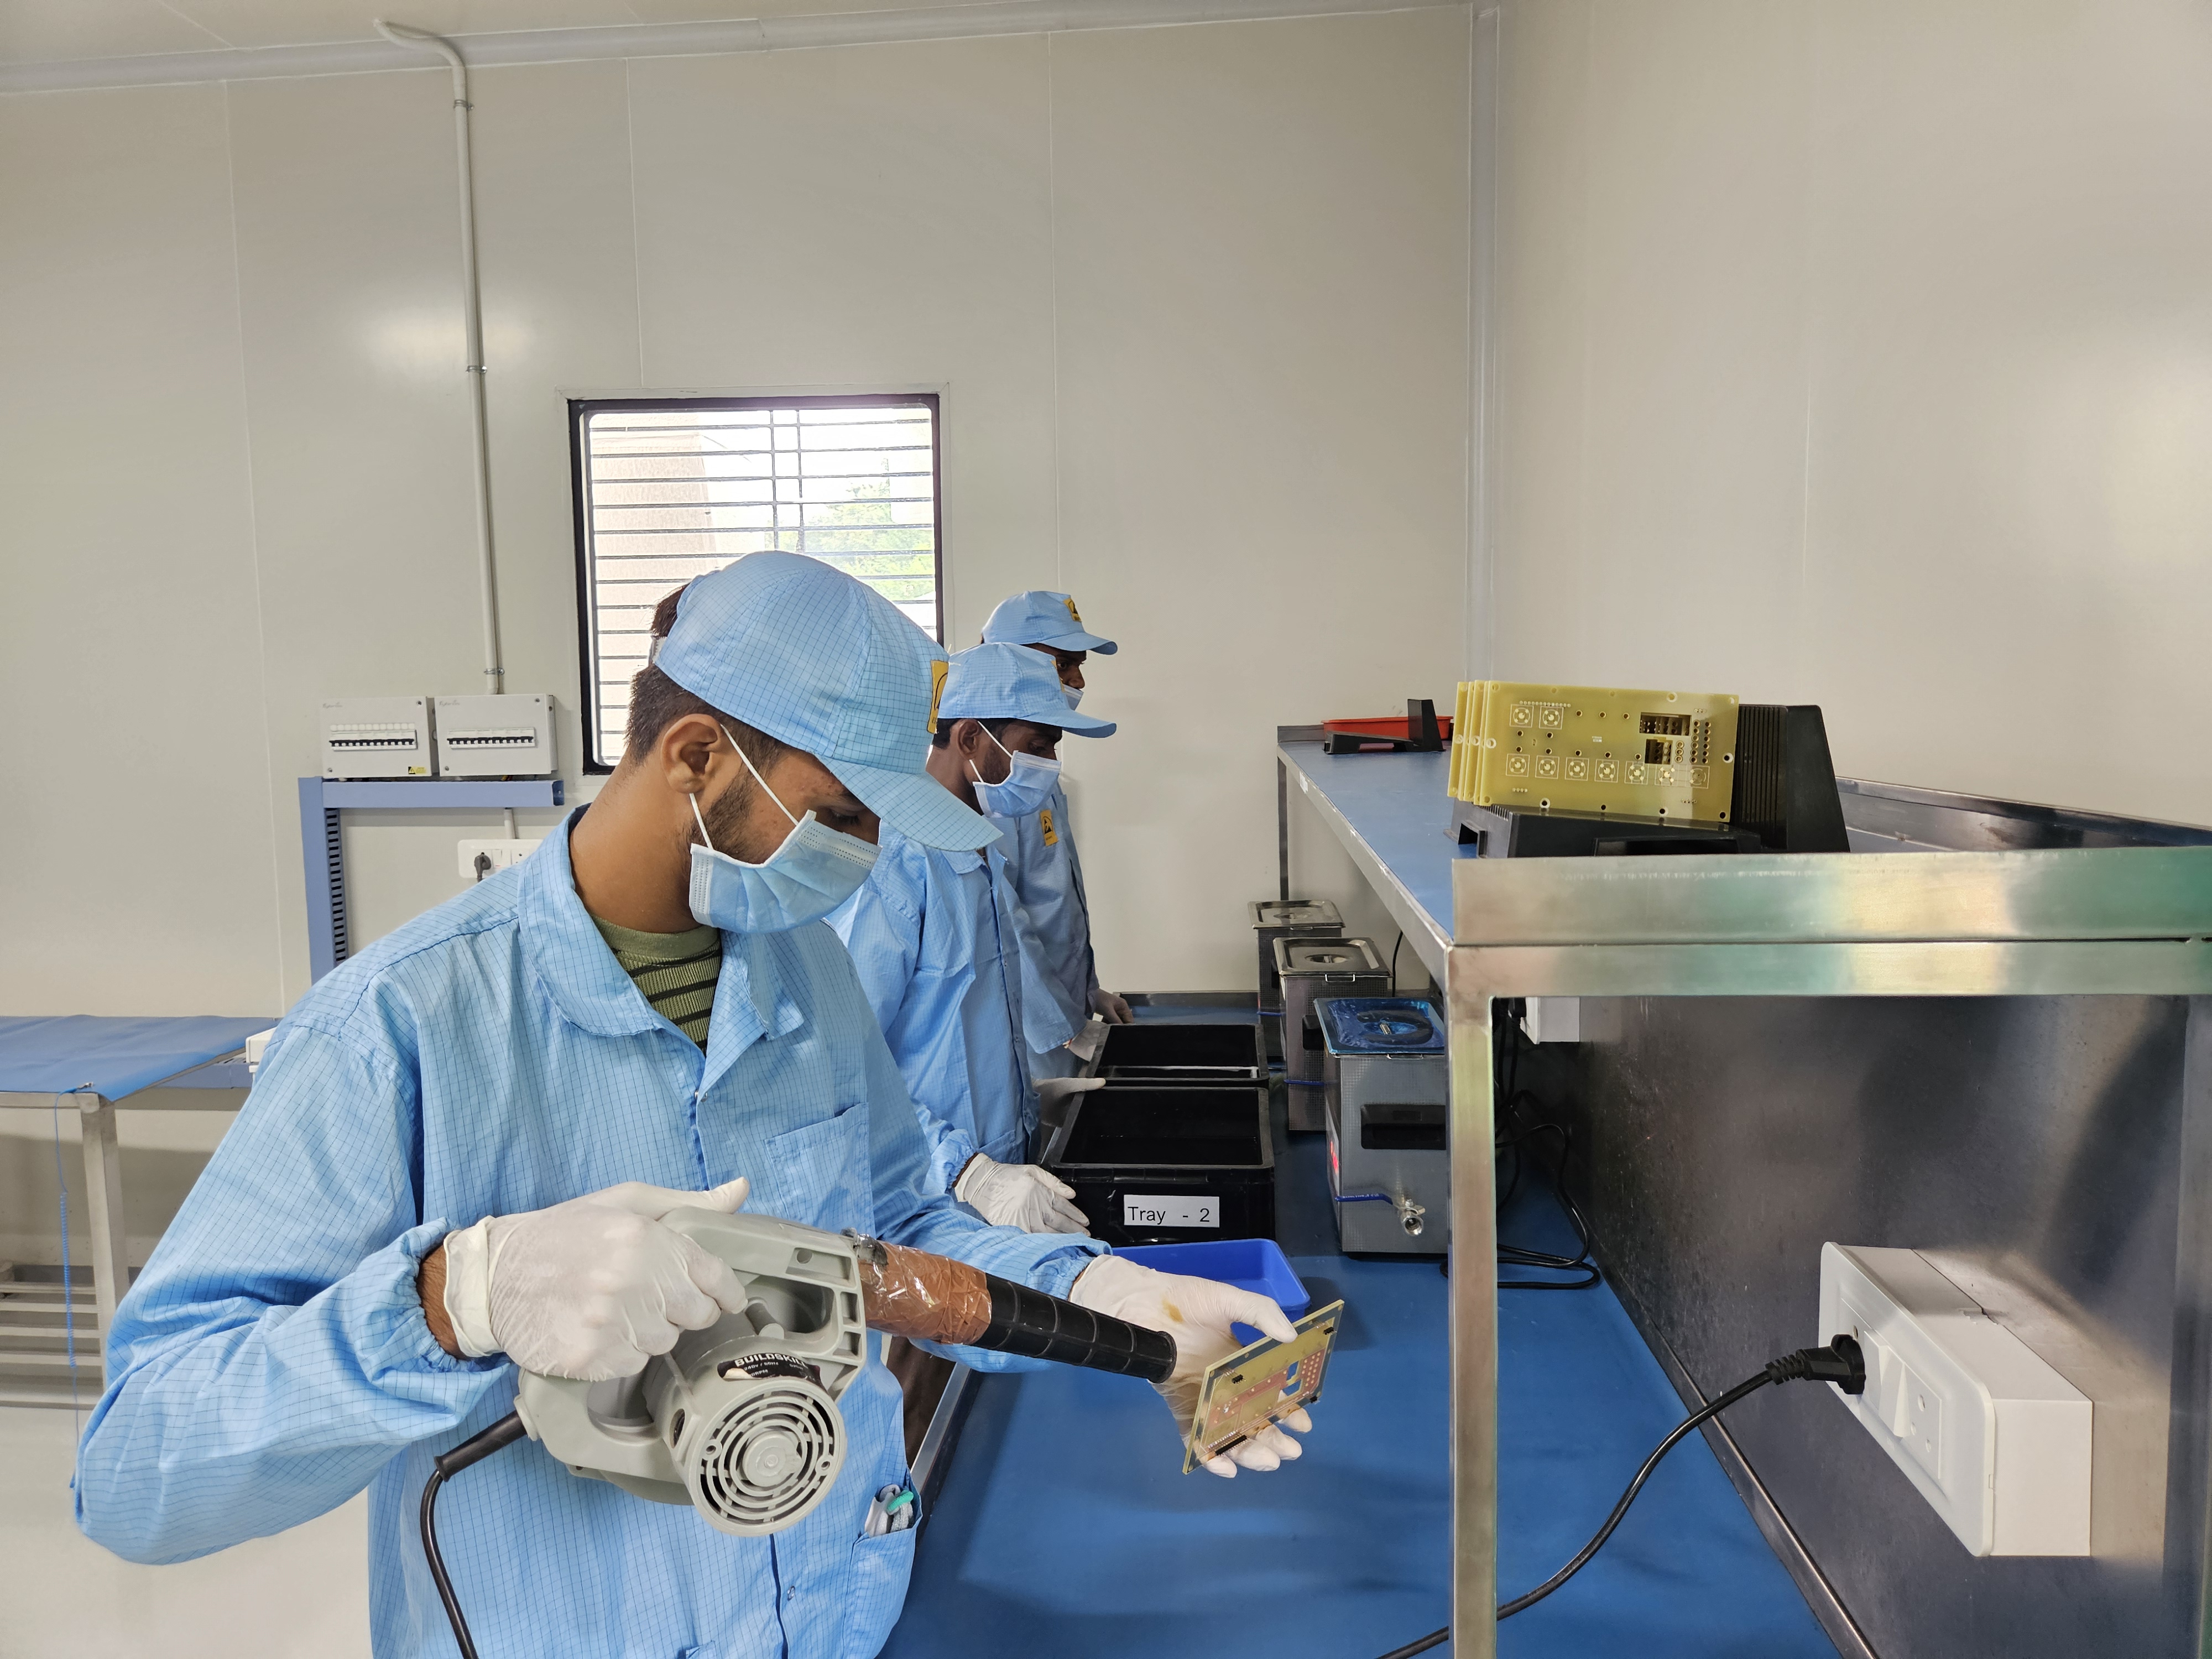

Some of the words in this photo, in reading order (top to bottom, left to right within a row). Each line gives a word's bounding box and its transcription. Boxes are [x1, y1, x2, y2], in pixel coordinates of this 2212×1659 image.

[1127, 1206, 1166, 1225] Tray
[1199, 1208, 1210, 1223] 2
[734, 1353, 808, 1369] BUILDSKILL
